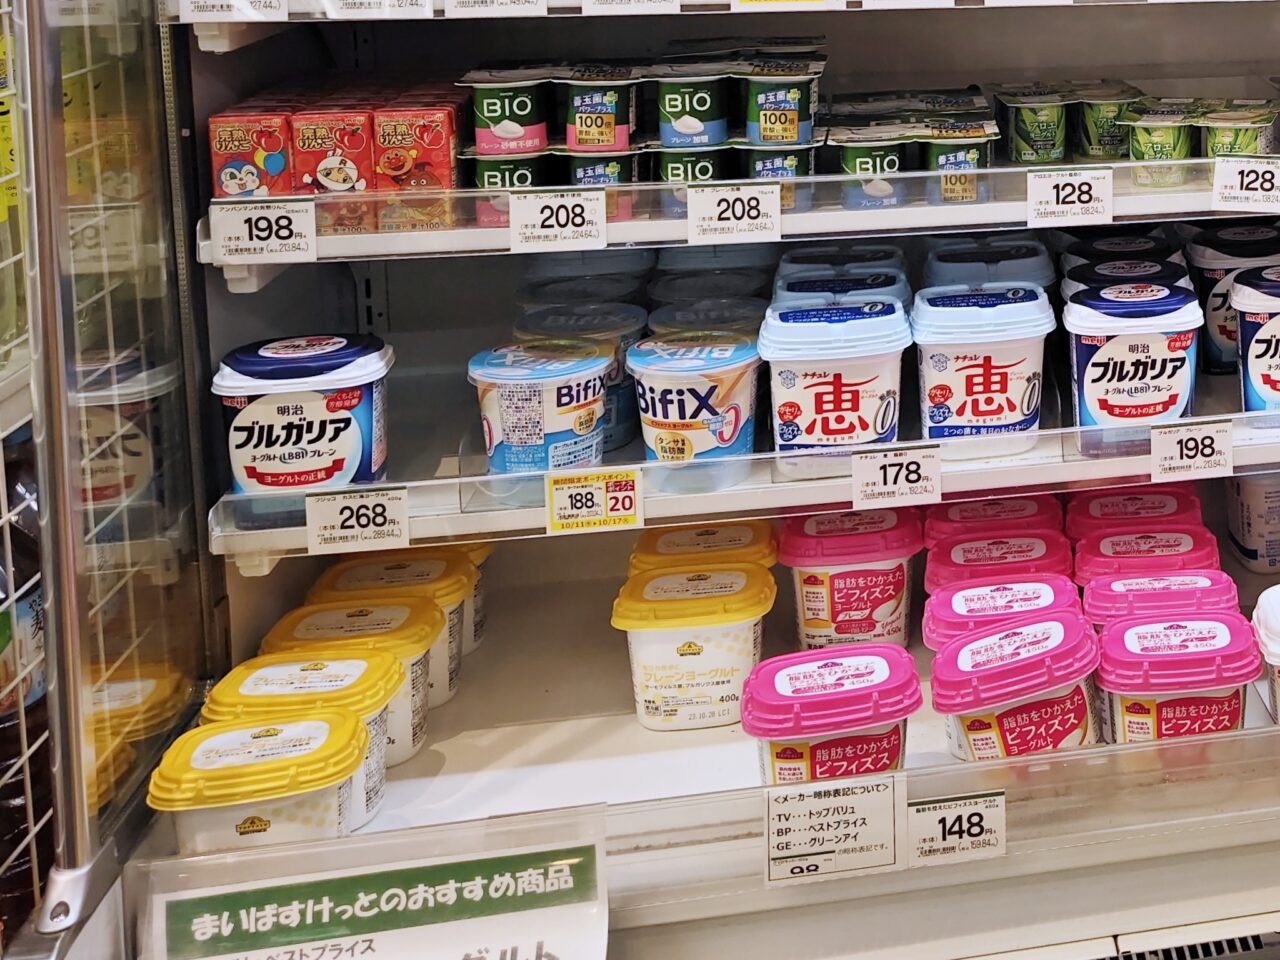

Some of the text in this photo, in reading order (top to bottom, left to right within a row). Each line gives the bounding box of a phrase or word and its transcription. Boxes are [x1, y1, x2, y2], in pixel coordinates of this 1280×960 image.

[483, 97, 531, 117] BIO
[665, 92, 709, 112] BIO
[856, 155, 899, 176] BIO
[1090, 356, 1186, 383] ブルガリア
[955, 356, 1027, 416] 恵
[223, 397, 248, 409] meiji
[276, 404, 303, 416] 明治
[805, 372, 877, 435] 恵
[233, 417, 352, 450] ブルガリア
[833, 570, 904, 589] 脂肪をひかえた
[833, 584, 896, 602] ビフィズス
[815, 734, 900, 761] 脂肪をひかえた
[814, 753, 891, 777] ビフィズス
[191, 864, 575, 941] まいばすけっとのおすすめ商品
